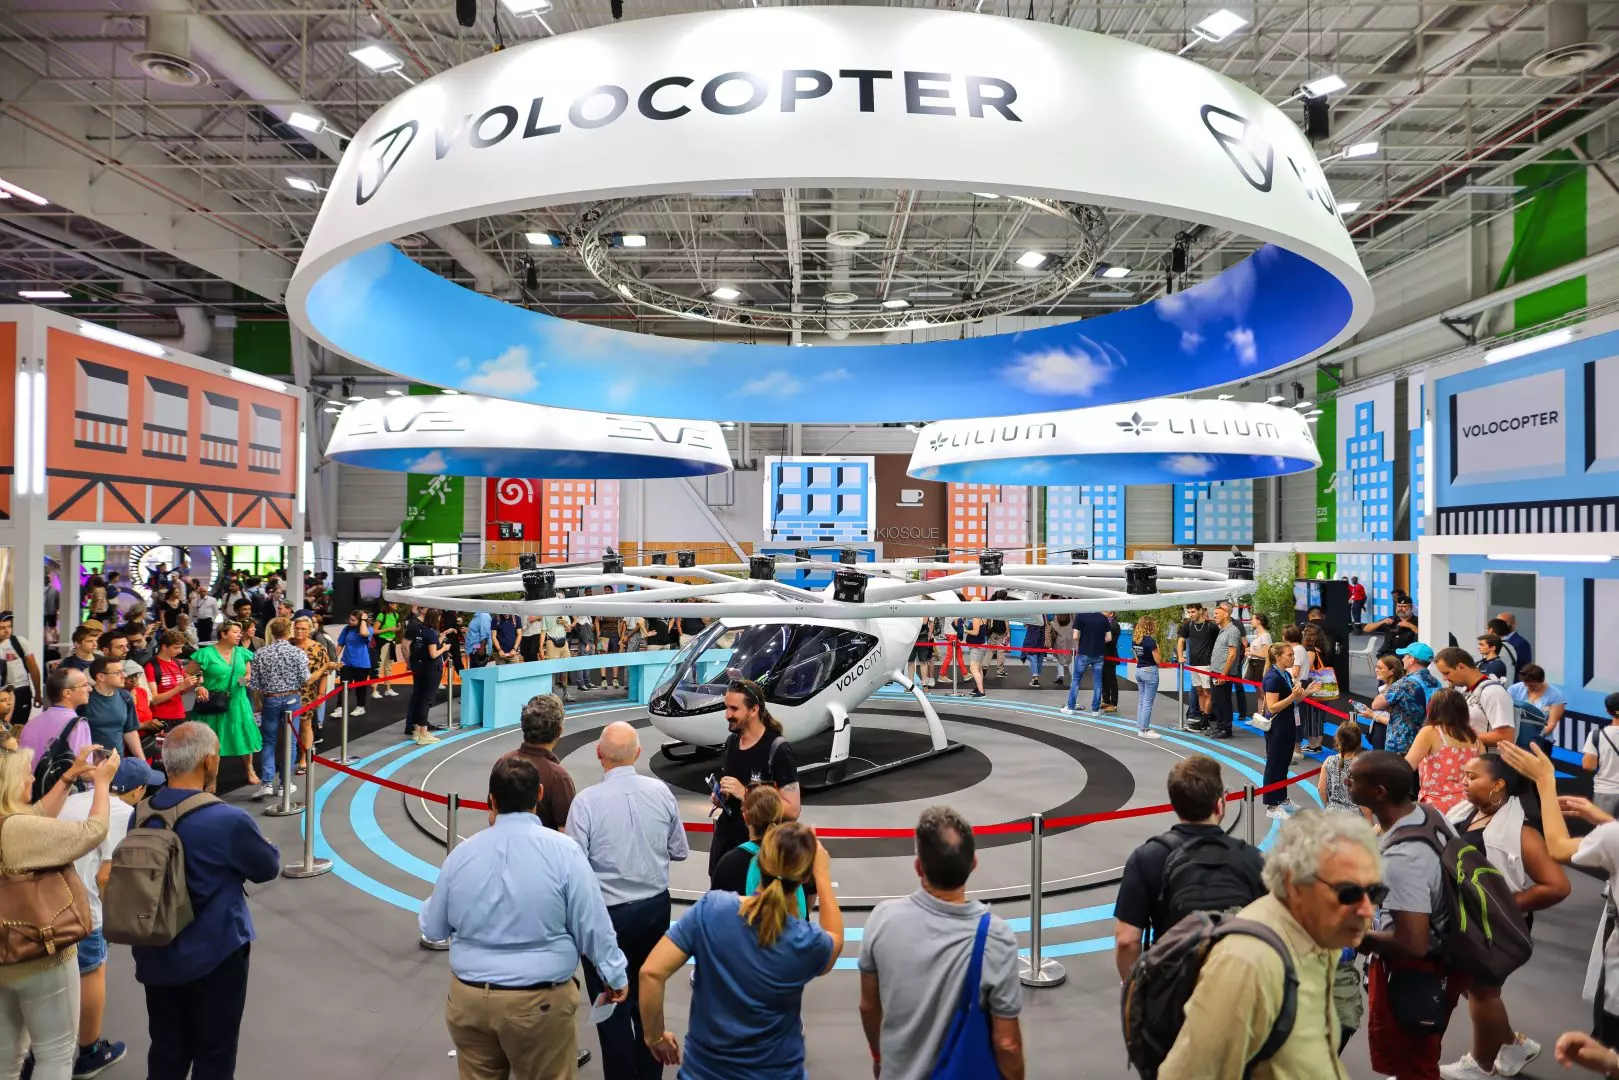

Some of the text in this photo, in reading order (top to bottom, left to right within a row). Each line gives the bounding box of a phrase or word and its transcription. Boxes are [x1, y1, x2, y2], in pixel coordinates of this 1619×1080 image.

[434, 69, 1023, 160] VOLOCOPTER
[1462, 410, 1559, 439] VOLOCOPTER
[876, 526, 940, 539] KIOSQUE
[836, 646, 882, 692] VOLOCITY
